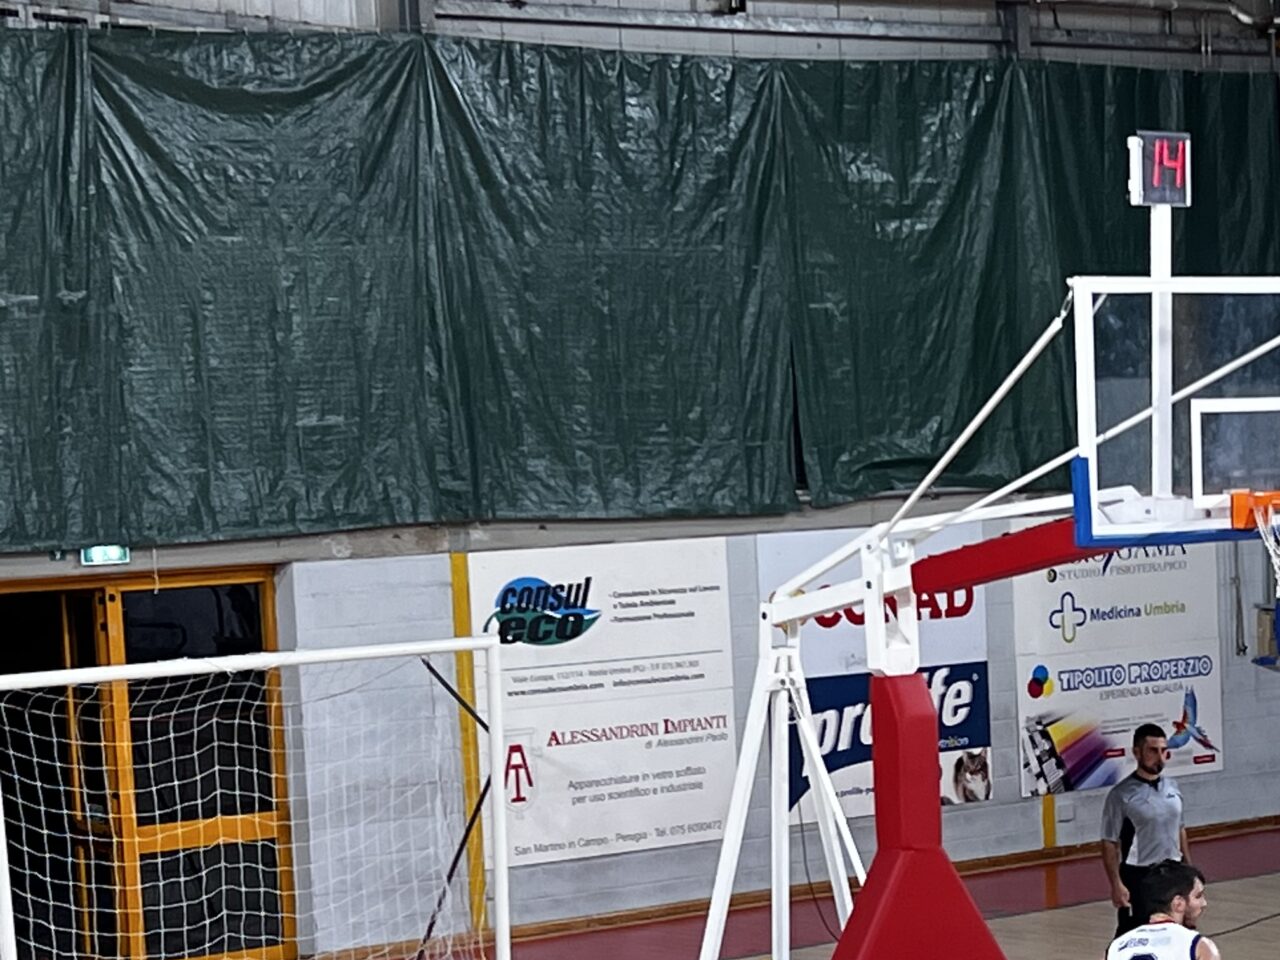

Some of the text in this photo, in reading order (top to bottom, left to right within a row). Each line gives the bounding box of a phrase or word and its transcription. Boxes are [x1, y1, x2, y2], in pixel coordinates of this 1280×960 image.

[1152, 138, 1185, 188] 14
[1059, 560, 1187, 581] STUDIO FISIOTERAPICO
[501, 577, 592, 614] consul
[1090, 601, 1186, 621] Medicina Umbria
[499, 612, 584, 644] eco
[1058, 655, 1213, 691] TIPOLITO PROPERZIO
[546, 715, 727, 747] ALESSANDRINI IMPIANTI
[514, 846, 532, 856] San
